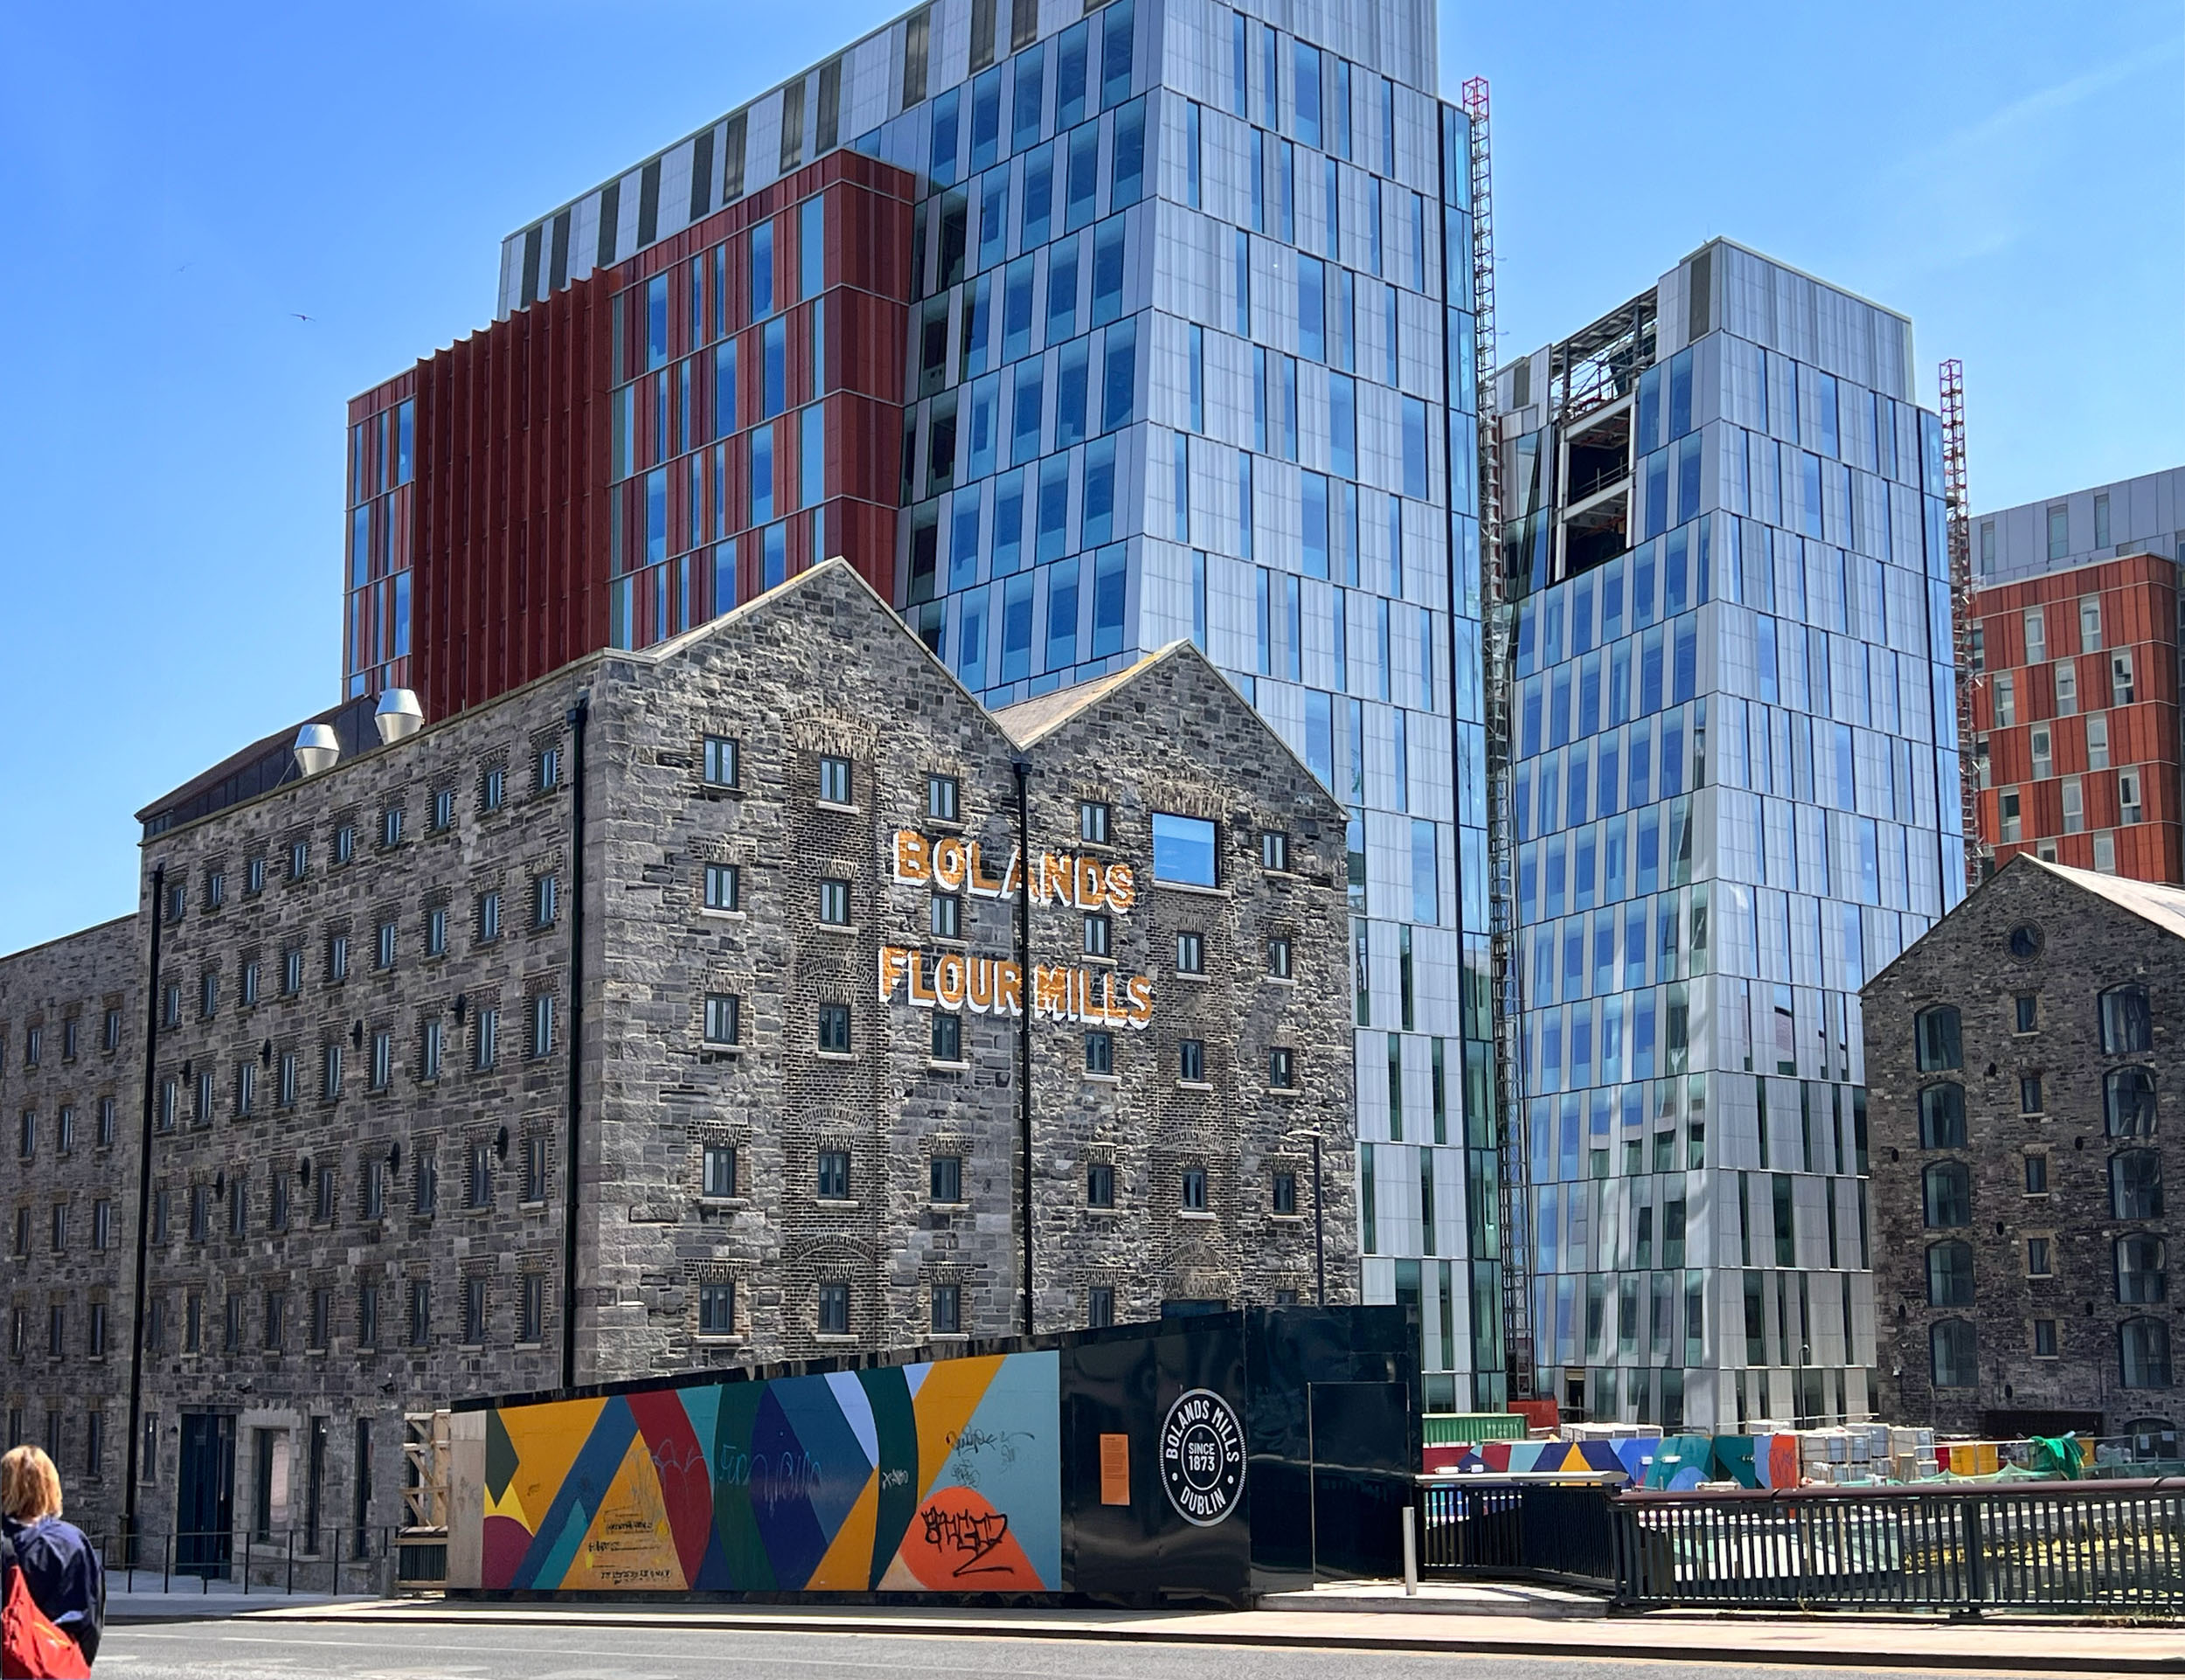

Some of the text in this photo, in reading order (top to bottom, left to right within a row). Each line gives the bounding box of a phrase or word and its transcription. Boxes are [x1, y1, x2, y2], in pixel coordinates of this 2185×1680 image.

[893, 830, 1136, 914] BOLANDS
[878, 946, 1154, 1030] FLOUR MILLS
[1166, 1400, 1210, 1460] BOLANDS
[1211, 1407, 1239, 1462] MILLS
[1188, 1442, 1216, 1455] SINCE
[1188, 1455, 1216, 1472] 1873
[1180, 1486, 1226, 1516] DUBLIN
